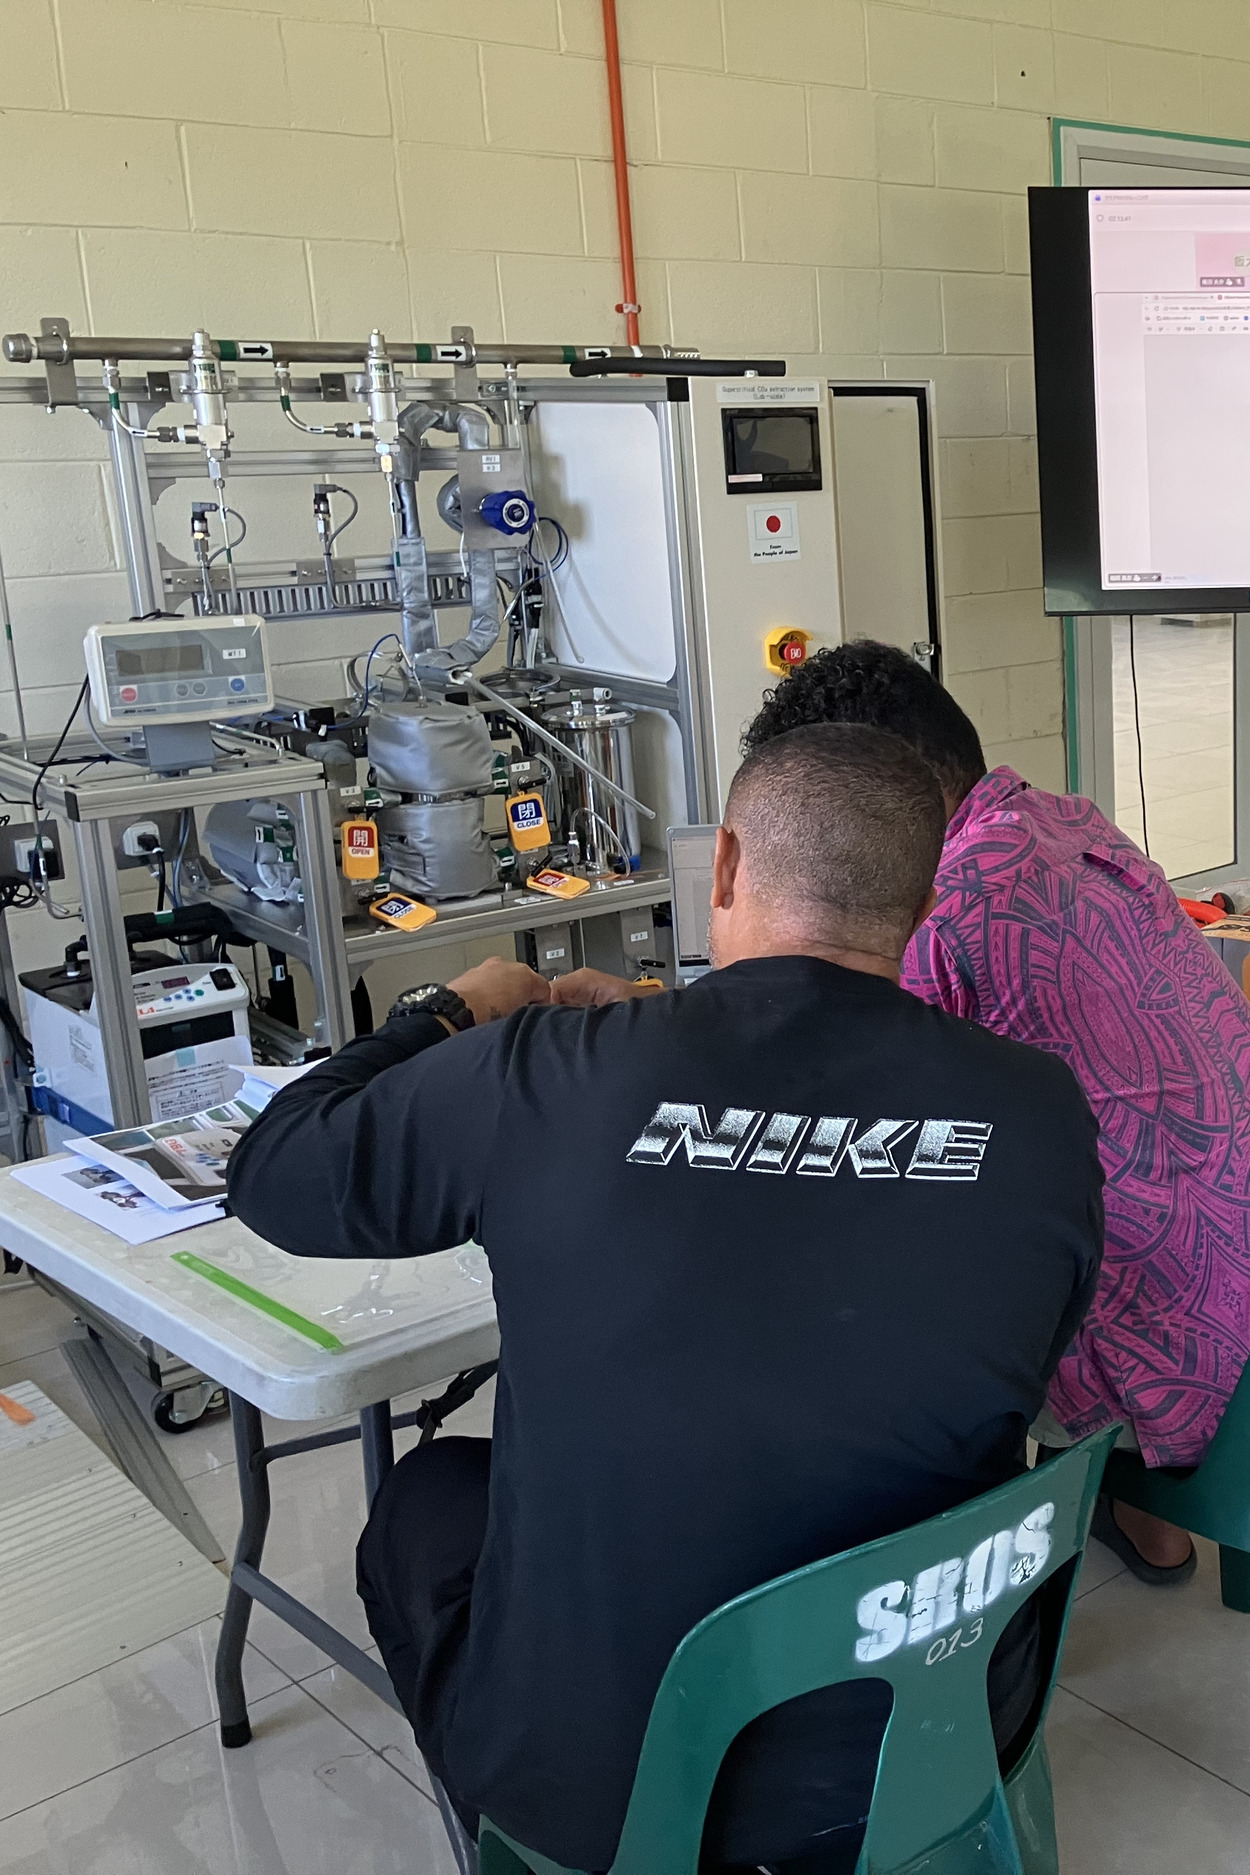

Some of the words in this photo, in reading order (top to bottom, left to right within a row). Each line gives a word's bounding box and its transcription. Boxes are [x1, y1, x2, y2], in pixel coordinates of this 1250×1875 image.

[517, 802, 536, 820] 閉
[516, 819, 542, 829] CLOSE
[353, 829, 369, 846] 開
[351, 848, 371, 856] OPEN
[624, 1101, 993, 1182] NIKE
[925, 1617, 984, 1666] 013
